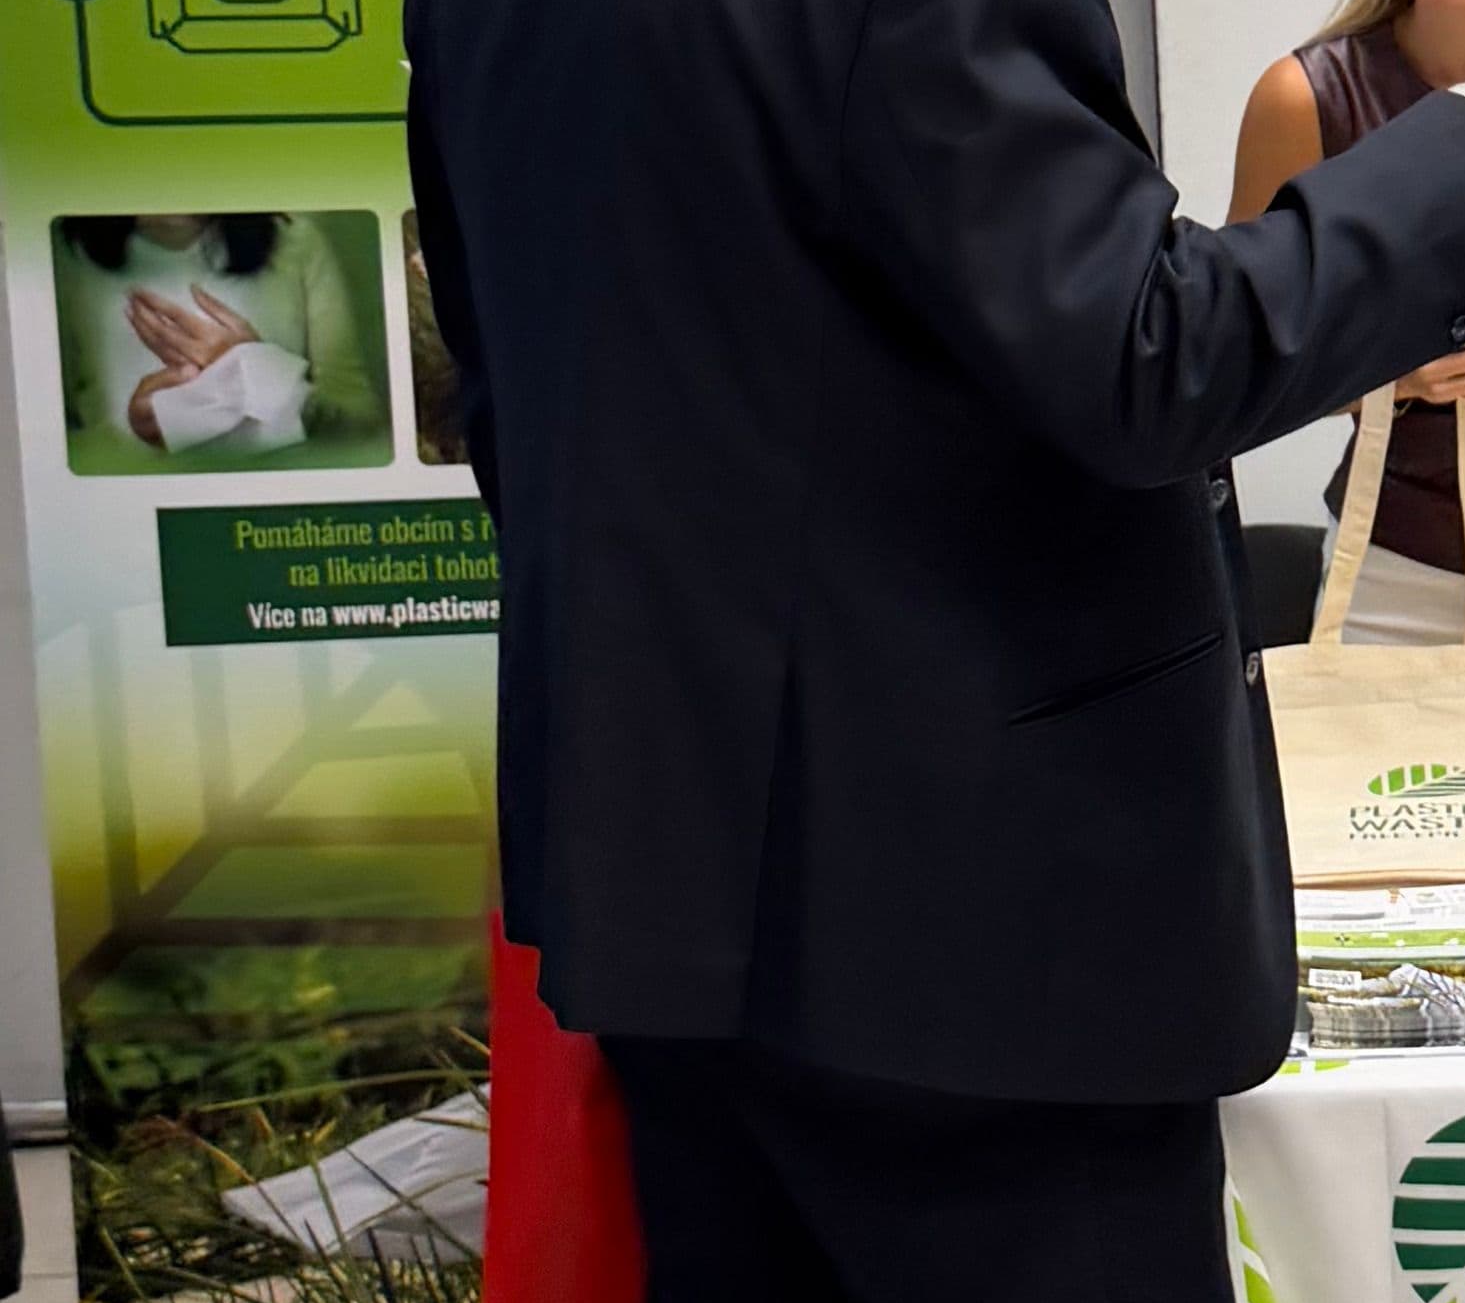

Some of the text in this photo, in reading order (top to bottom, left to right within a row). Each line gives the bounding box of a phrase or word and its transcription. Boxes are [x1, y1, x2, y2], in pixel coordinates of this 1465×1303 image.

[235, 516, 372, 550] Pomáháme
[380, 513, 455, 544] obcím
[460, 519, 475, 542] s
[288, 564, 320, 588] na
[326, 553, 428, 587] likvidaci
[247, 602, 296, 630] Více
[301, 606, 328, 628] na
